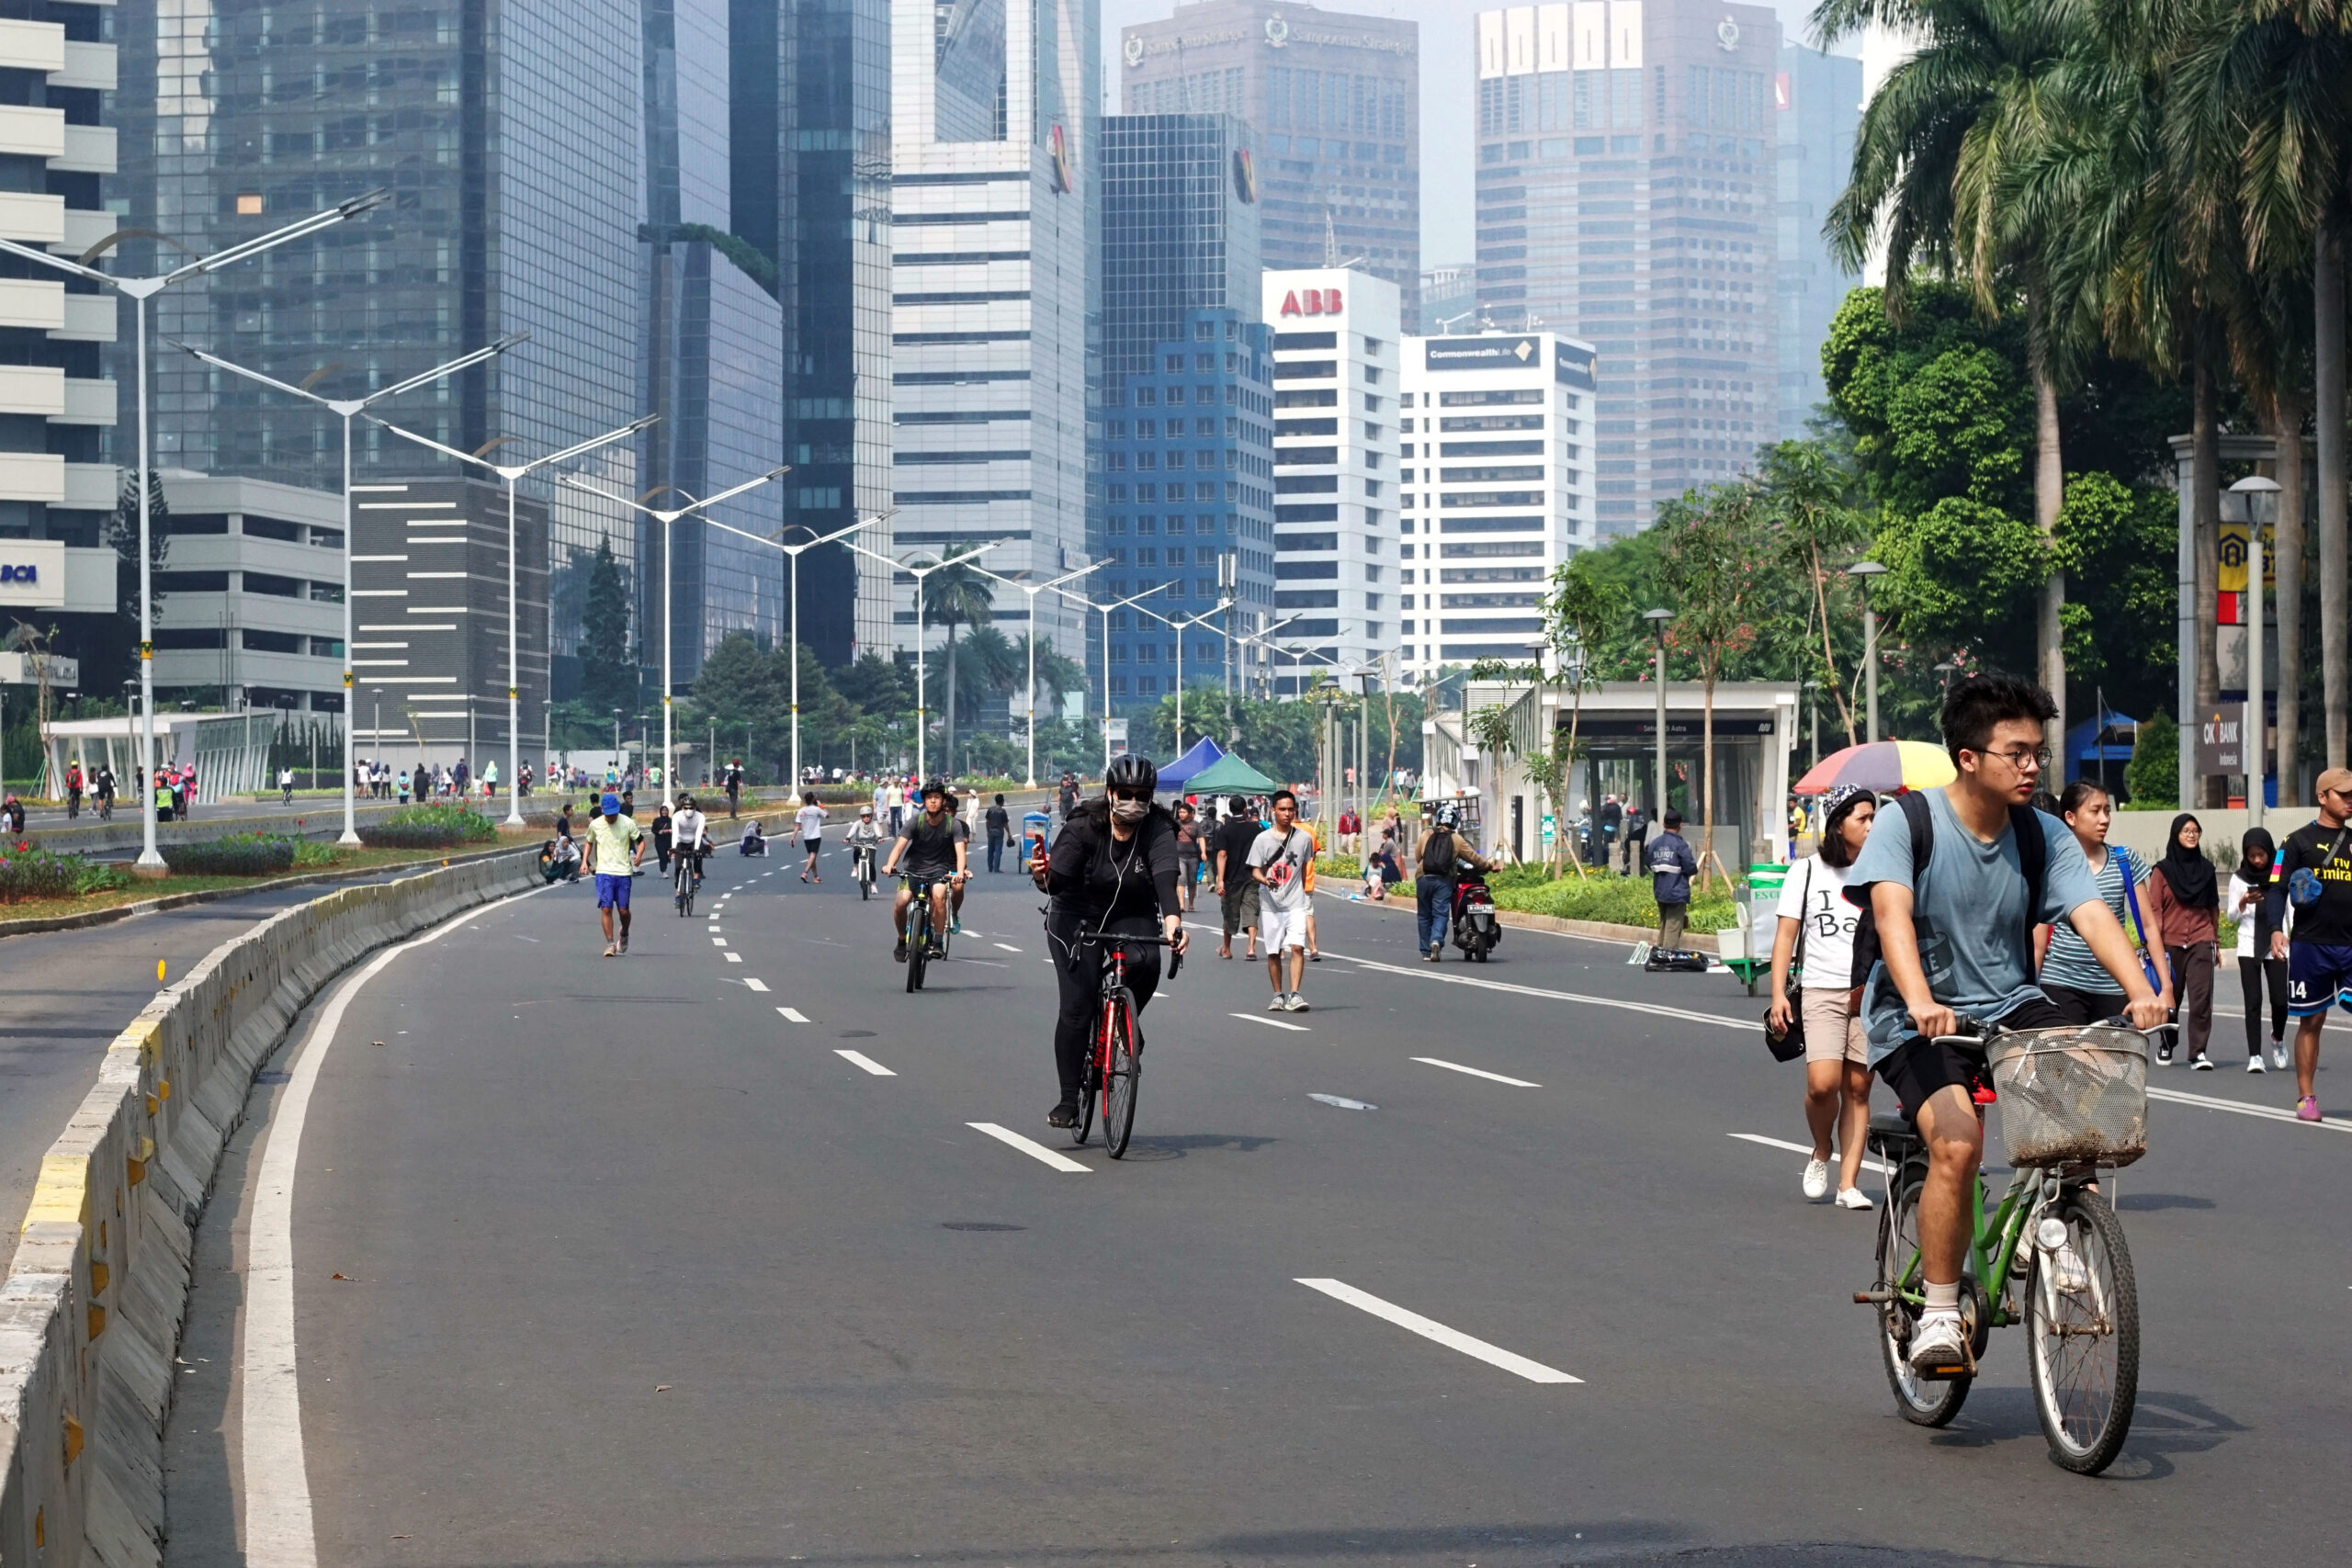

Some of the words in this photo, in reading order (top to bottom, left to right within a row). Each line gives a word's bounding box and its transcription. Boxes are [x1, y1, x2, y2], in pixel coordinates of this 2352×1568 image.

[1280, 288, 1343, 315] ABB
[0, 564, 37, 583] BCA
[1671, 724, 1687, 733] Astra
[2219, 721, 2238, 744] BANK
[2334, 857, 2350, 870] Fly
[1817, 890, 1834, 912] I
[2289, 980, 2307, 999] 14
